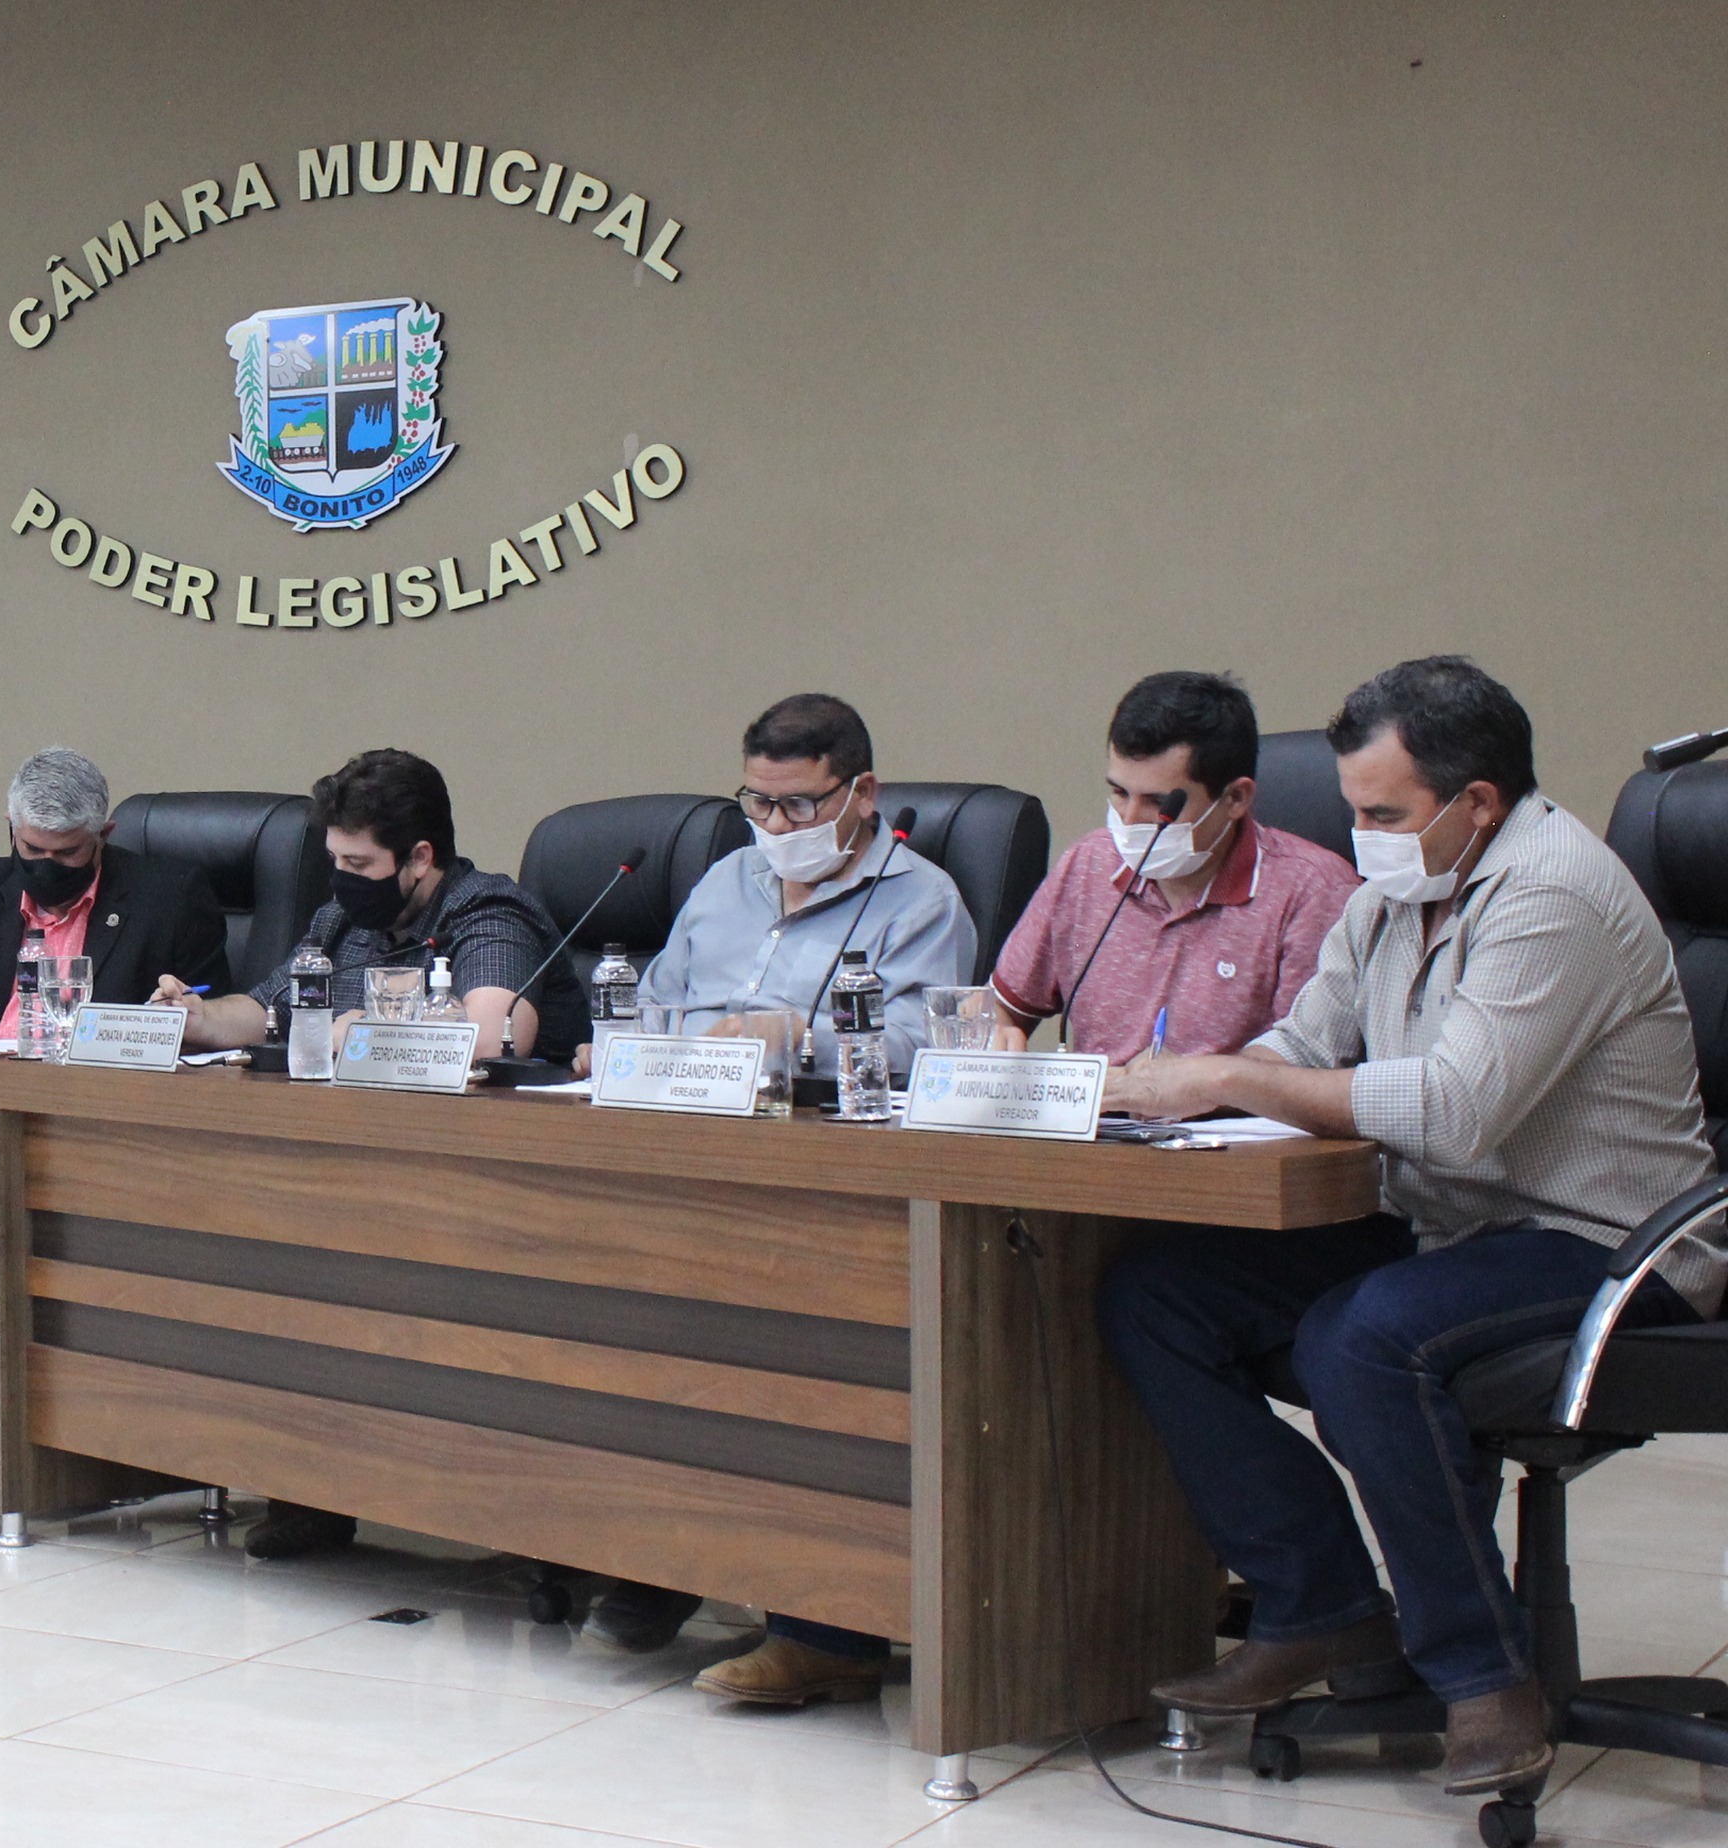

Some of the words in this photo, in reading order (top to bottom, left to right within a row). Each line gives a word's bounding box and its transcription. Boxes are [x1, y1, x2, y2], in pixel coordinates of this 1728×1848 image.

[9, 162, 276, 349] CÂMARA
[298, 140, 683, 283] MUNICIPAL
[239, 464, 271, 495] 2-10
[397, 457, 428, 485] 1948
[282, 488, 386, 518] BONITO
[11, 488, 217, 620] PODER
[236, 443, 683, 627] LEGISLATIVO
[123, 1030, 148, 1044] JACQUES
[148, 1031, 176, 1045] MARQUES
[373, 1030, 396, 1039] CÂMARA
[398, 1031, 426, 1041] MUNICIPAL
[427, 1033, 434, 1041] DE
[436, 1033, 457, 1042] BONITO
[462, 1034, 470, 1043] MS
[371, 1046, 393, 1061] PEDRO
[393, 1047, 432, 1064] APARECIDO
[640, 1044, 667, 1055] CÂMARA
[669, 1047, 702, 1057] MUNICIPAL
[704, 1048, 713, 1057] DE
[715, 1049, 740, 1059] BONITO
[745, 1051, 756, 1060] MS
[397, 1066, 428, 1077] VEREADOR
[645, 1060, 674, 1077] LUCAS
[675, 1062, 718, 1080] LEANDRO
[719, 1065, 743, 1082] PAES
[956, 1060, 989, 1073] CÂMARA
[990, 1063, 1032, 1076] MUNICIPAL
[1034, 1066, 1044, 1077] DE
[1046, 1067, 1077, 1078] BONITO
[1083, 1069, 1096, 1078] MS
[670, 1086, 709, 1099] VEREADOR
[955, 1080, 1009, 1100] AURIVALDO
[1013, 1083, 1045, 1101] NUNES
[1046, 1085, 1087, 1108] FRANÇA
[994, 1107, 1039, 1121] VEREADOR
